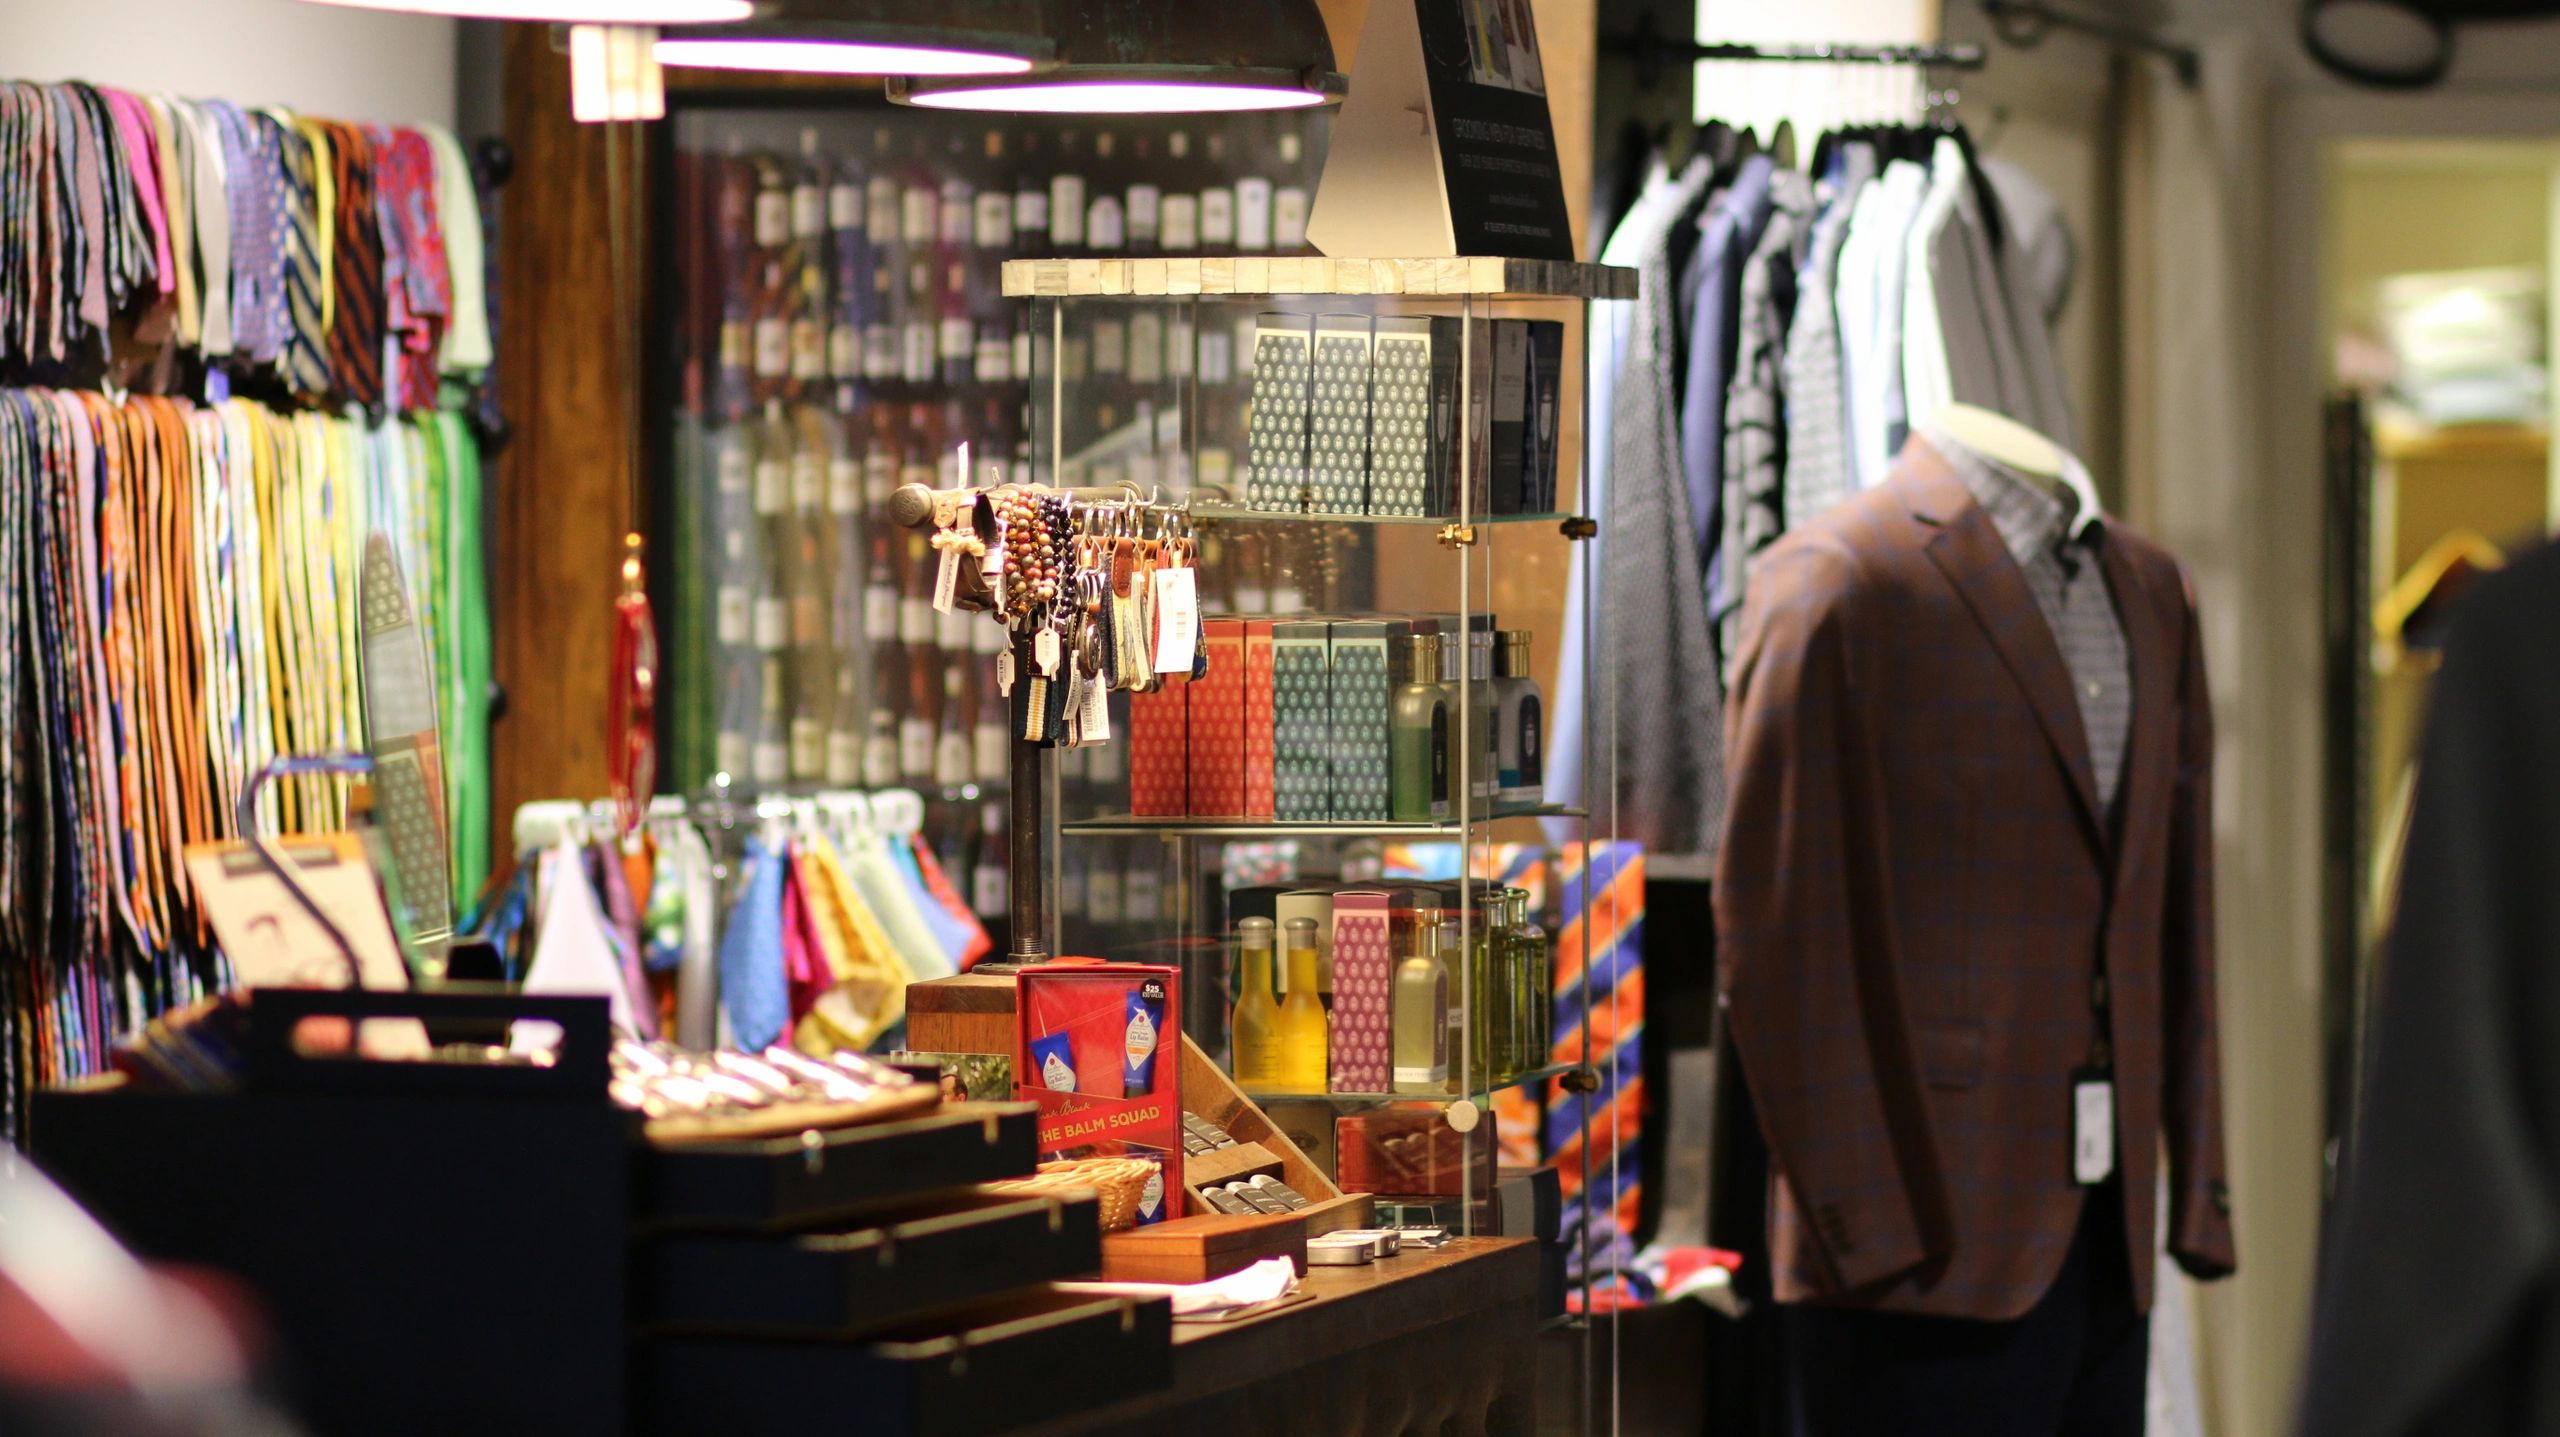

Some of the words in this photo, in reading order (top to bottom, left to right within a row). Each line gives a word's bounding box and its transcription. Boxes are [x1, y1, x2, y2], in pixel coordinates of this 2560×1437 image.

[1145, 984, 1160, 993] $25
[1064, 1117, 1106, 1138] BALM
[1109, 1106, 1160, 1128] SQUAD
